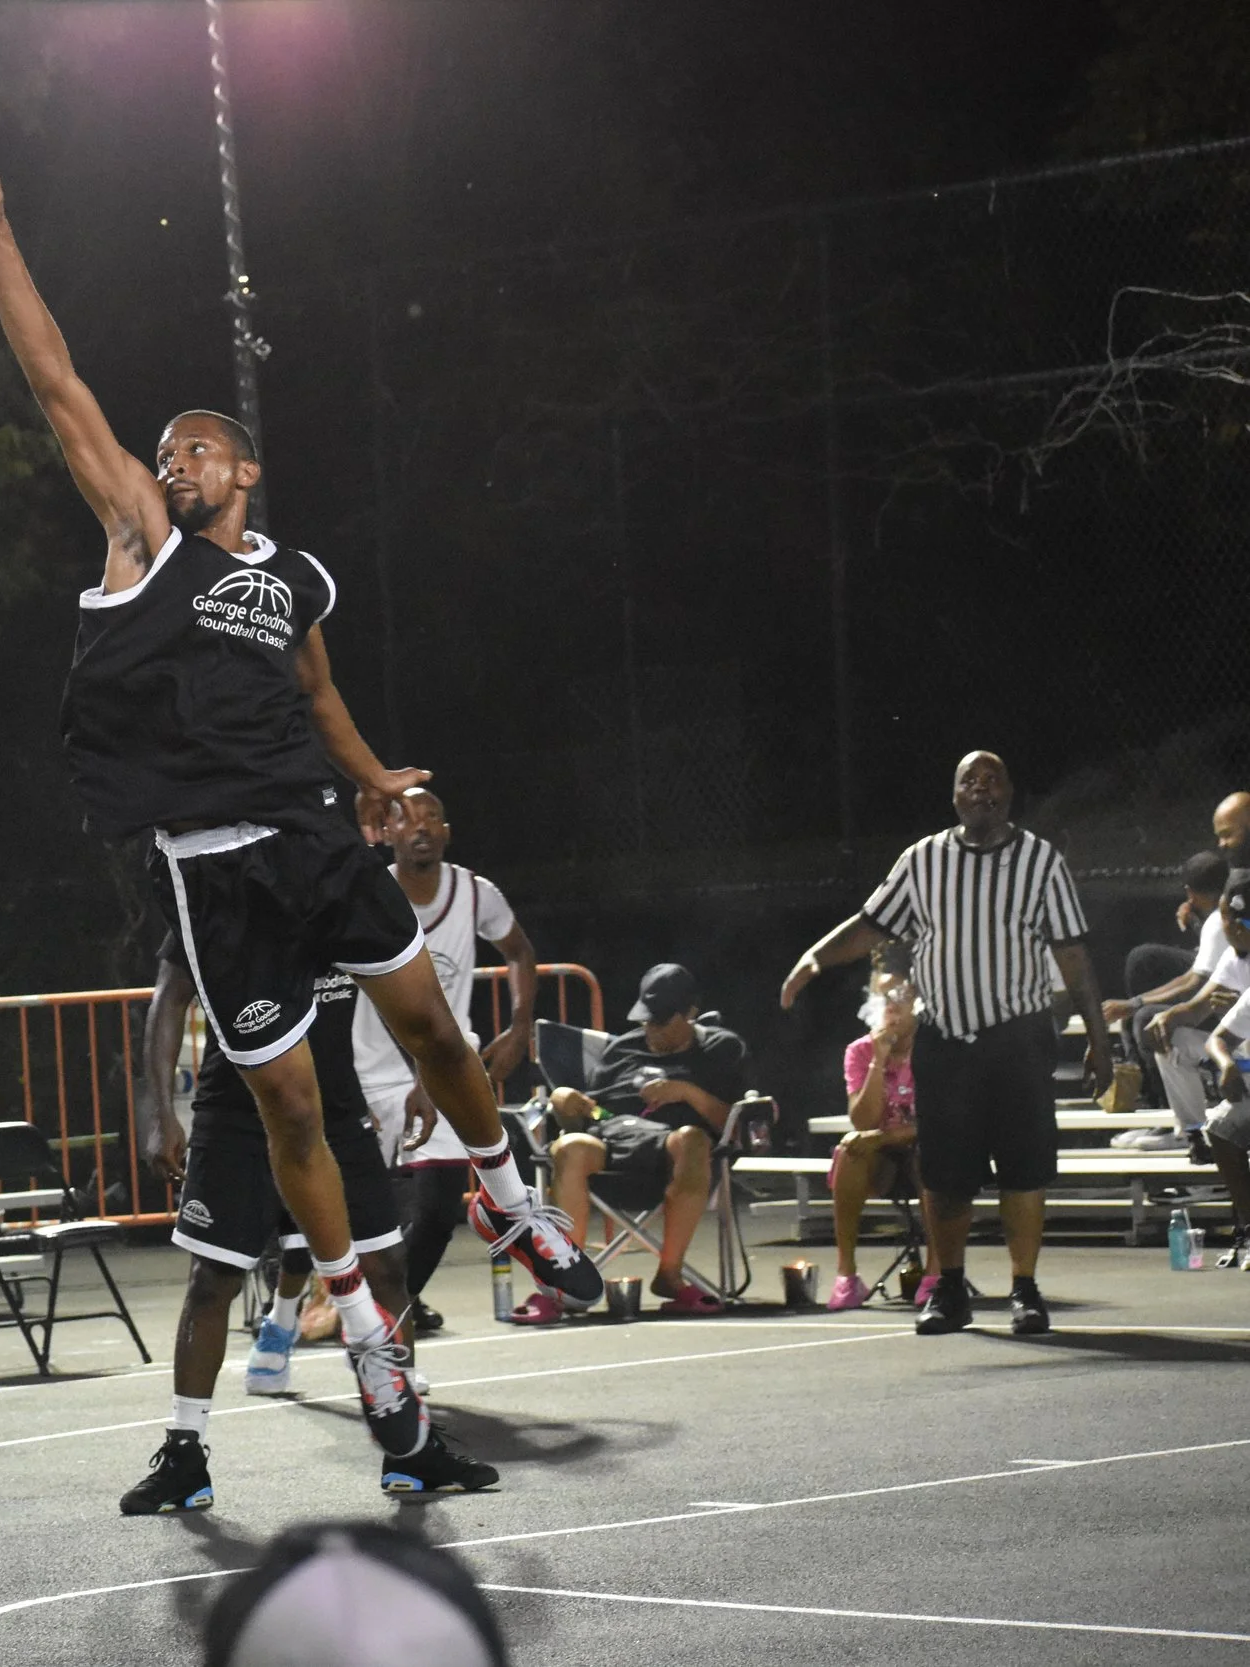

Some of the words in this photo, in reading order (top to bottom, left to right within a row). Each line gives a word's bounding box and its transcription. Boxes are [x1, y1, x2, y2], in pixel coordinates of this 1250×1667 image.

[192, 595, 247, 621] George
[196, 615, 257, 640] Roundball
[256, 629, 288, 651] Classic
[330, 1272, 362, 1297] NIK
